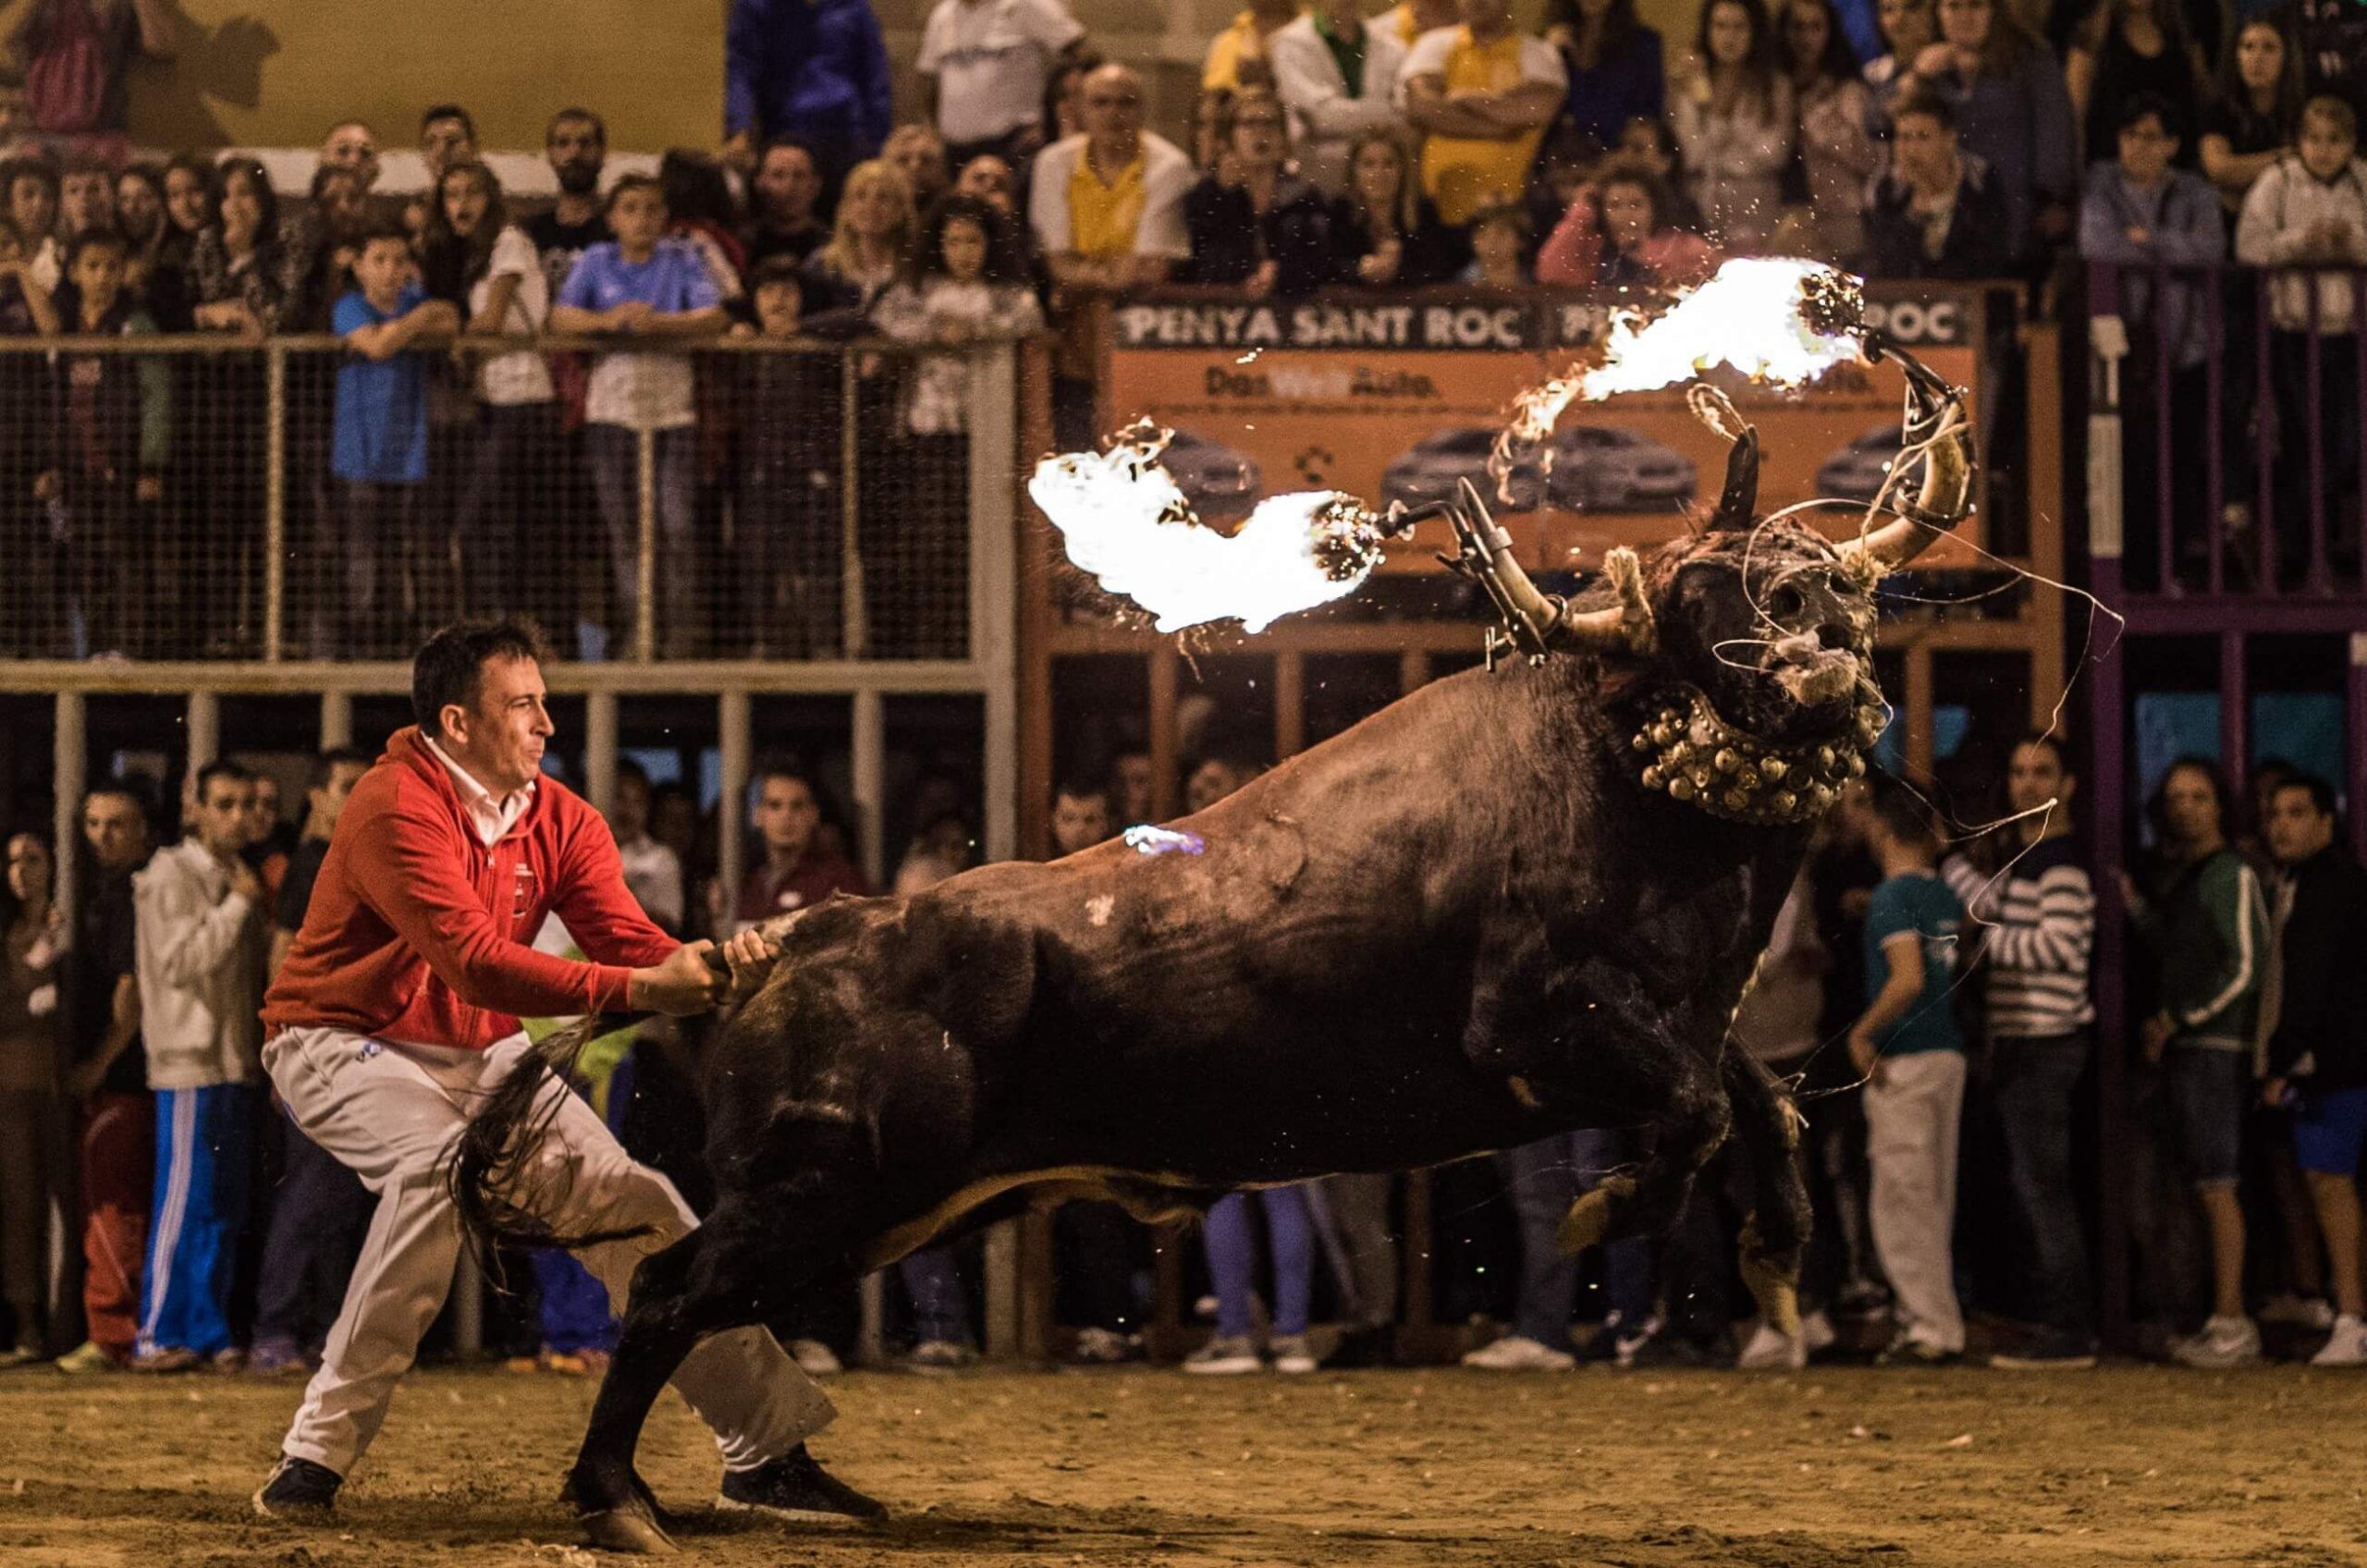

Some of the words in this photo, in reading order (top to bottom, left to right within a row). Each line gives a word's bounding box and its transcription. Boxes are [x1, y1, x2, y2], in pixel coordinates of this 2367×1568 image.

[1118, 306, 1281, 343] PENYA
[1291, 306, 1413, 344] SANT
[1424, 306, 1522, 346] ROC
